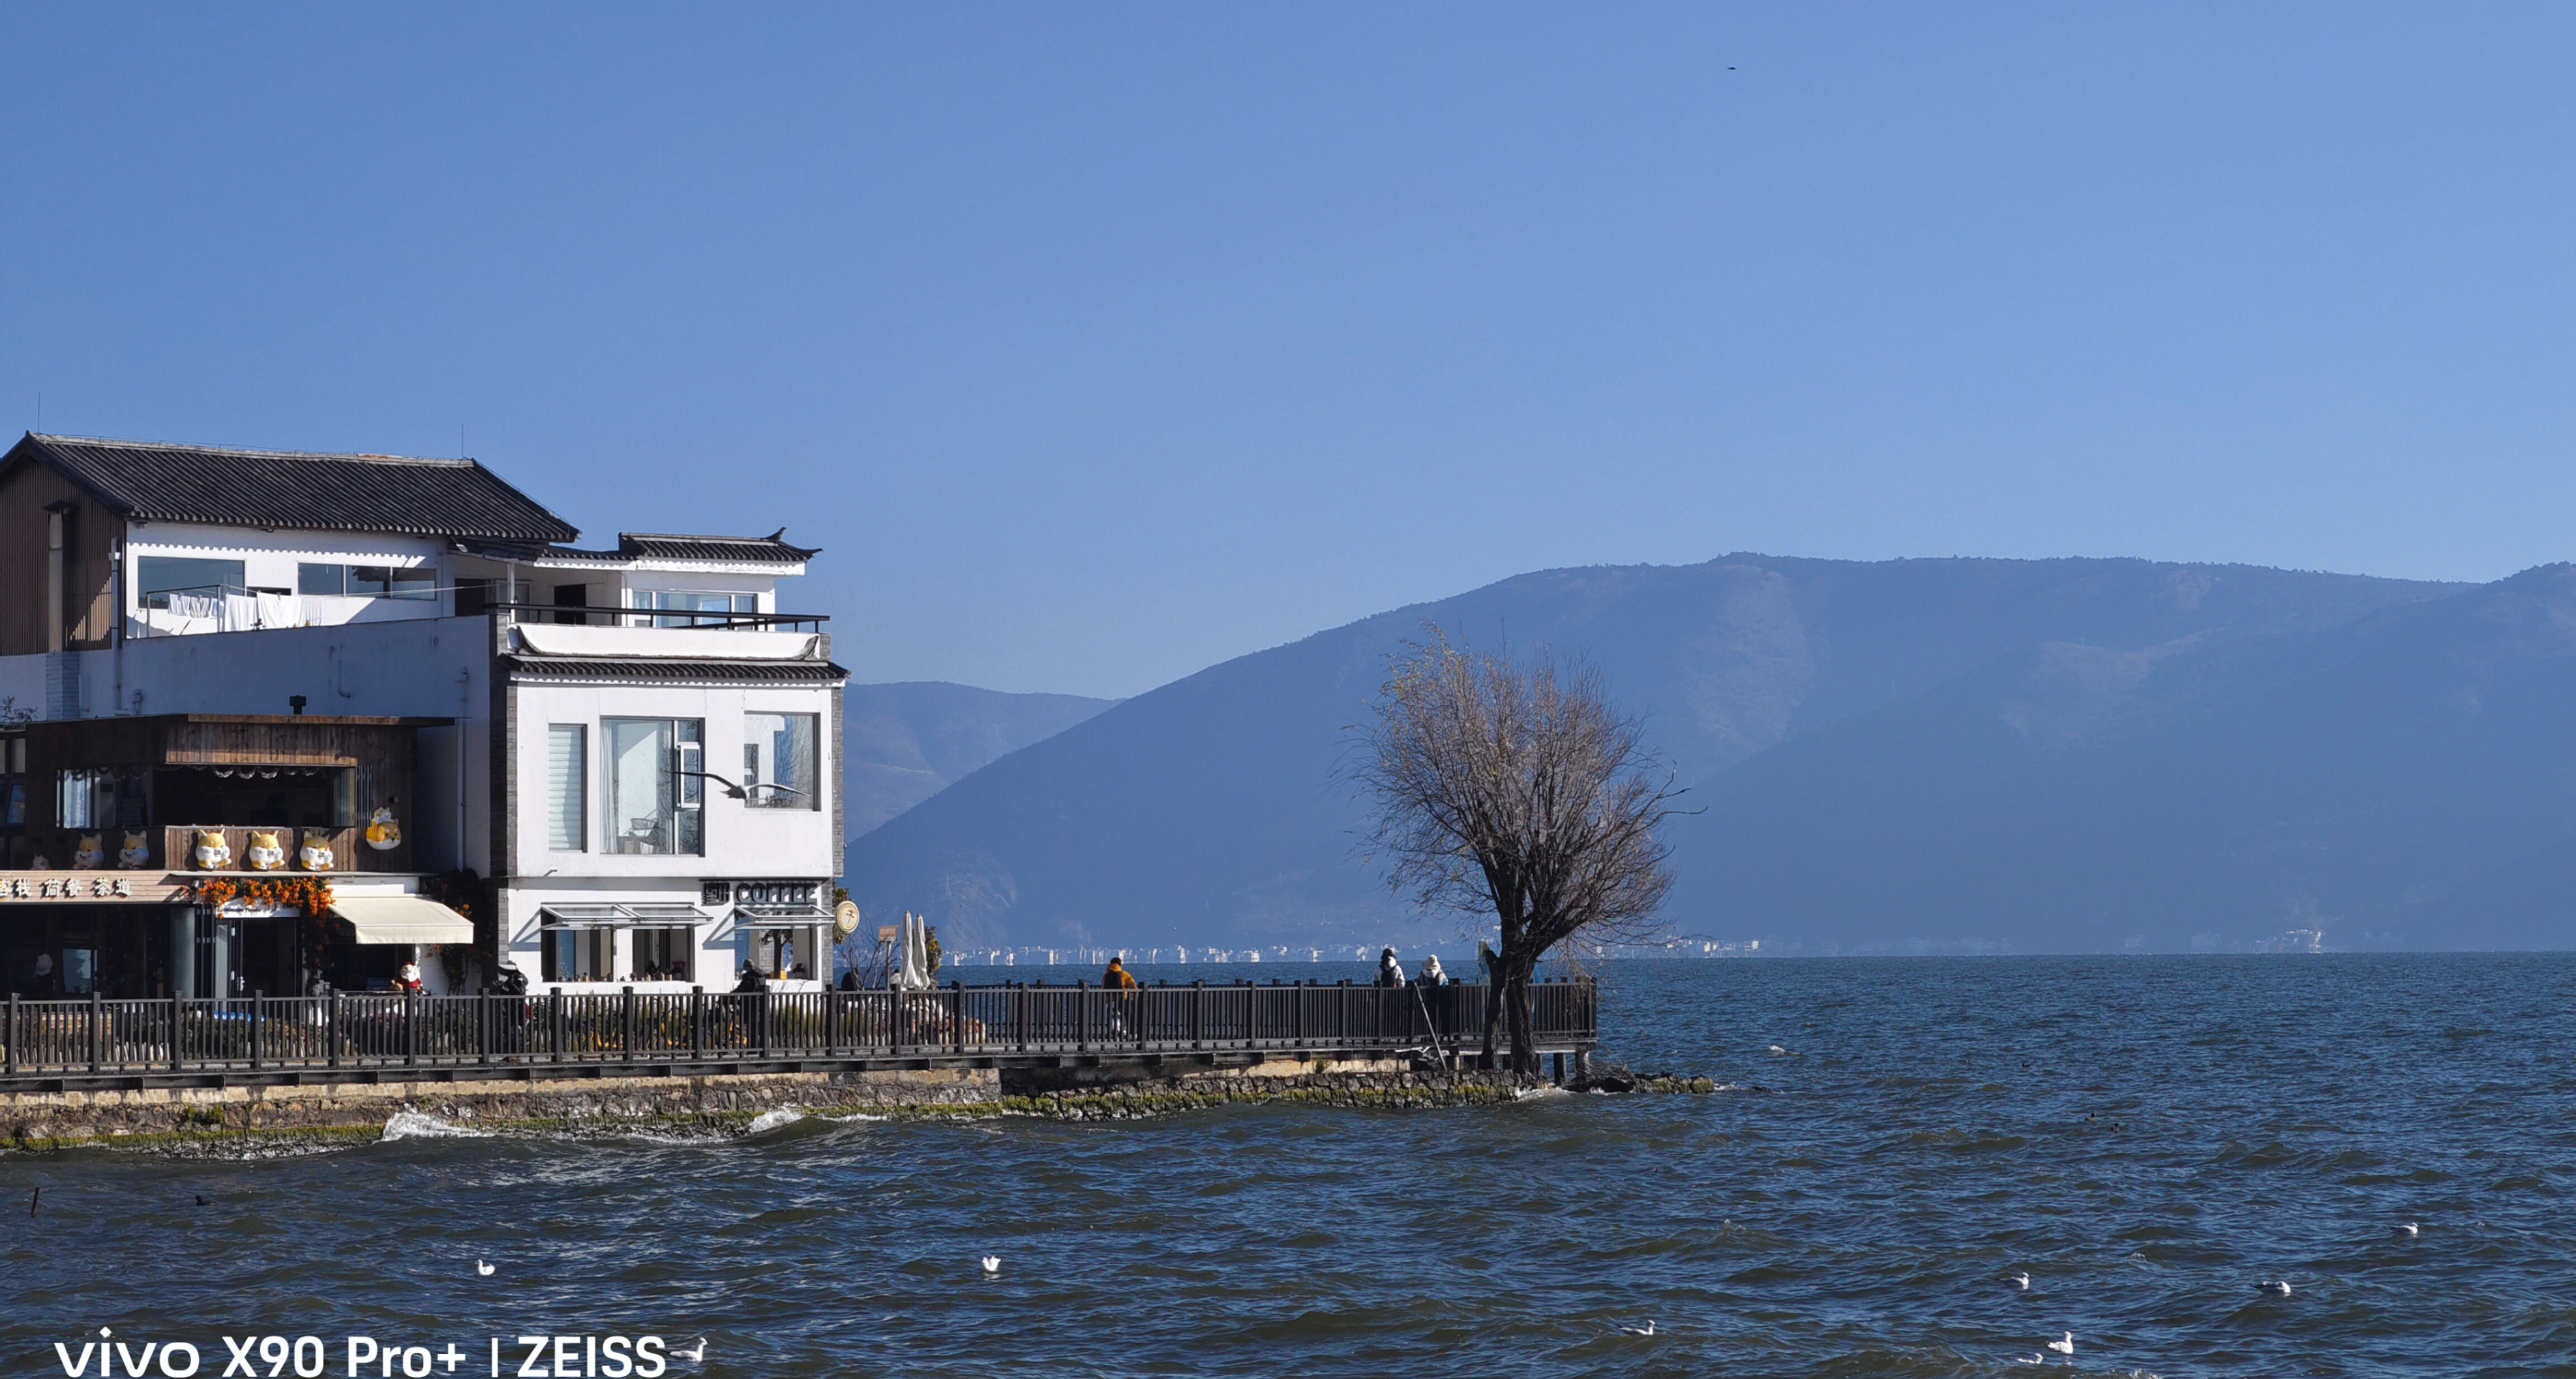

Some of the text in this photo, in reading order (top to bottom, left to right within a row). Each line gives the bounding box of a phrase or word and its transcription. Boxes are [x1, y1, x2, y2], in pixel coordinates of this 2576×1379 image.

[0, 877, 133, 897] 客栈 简餐 茶道
[735, 882, 818, 903] COFFEE
